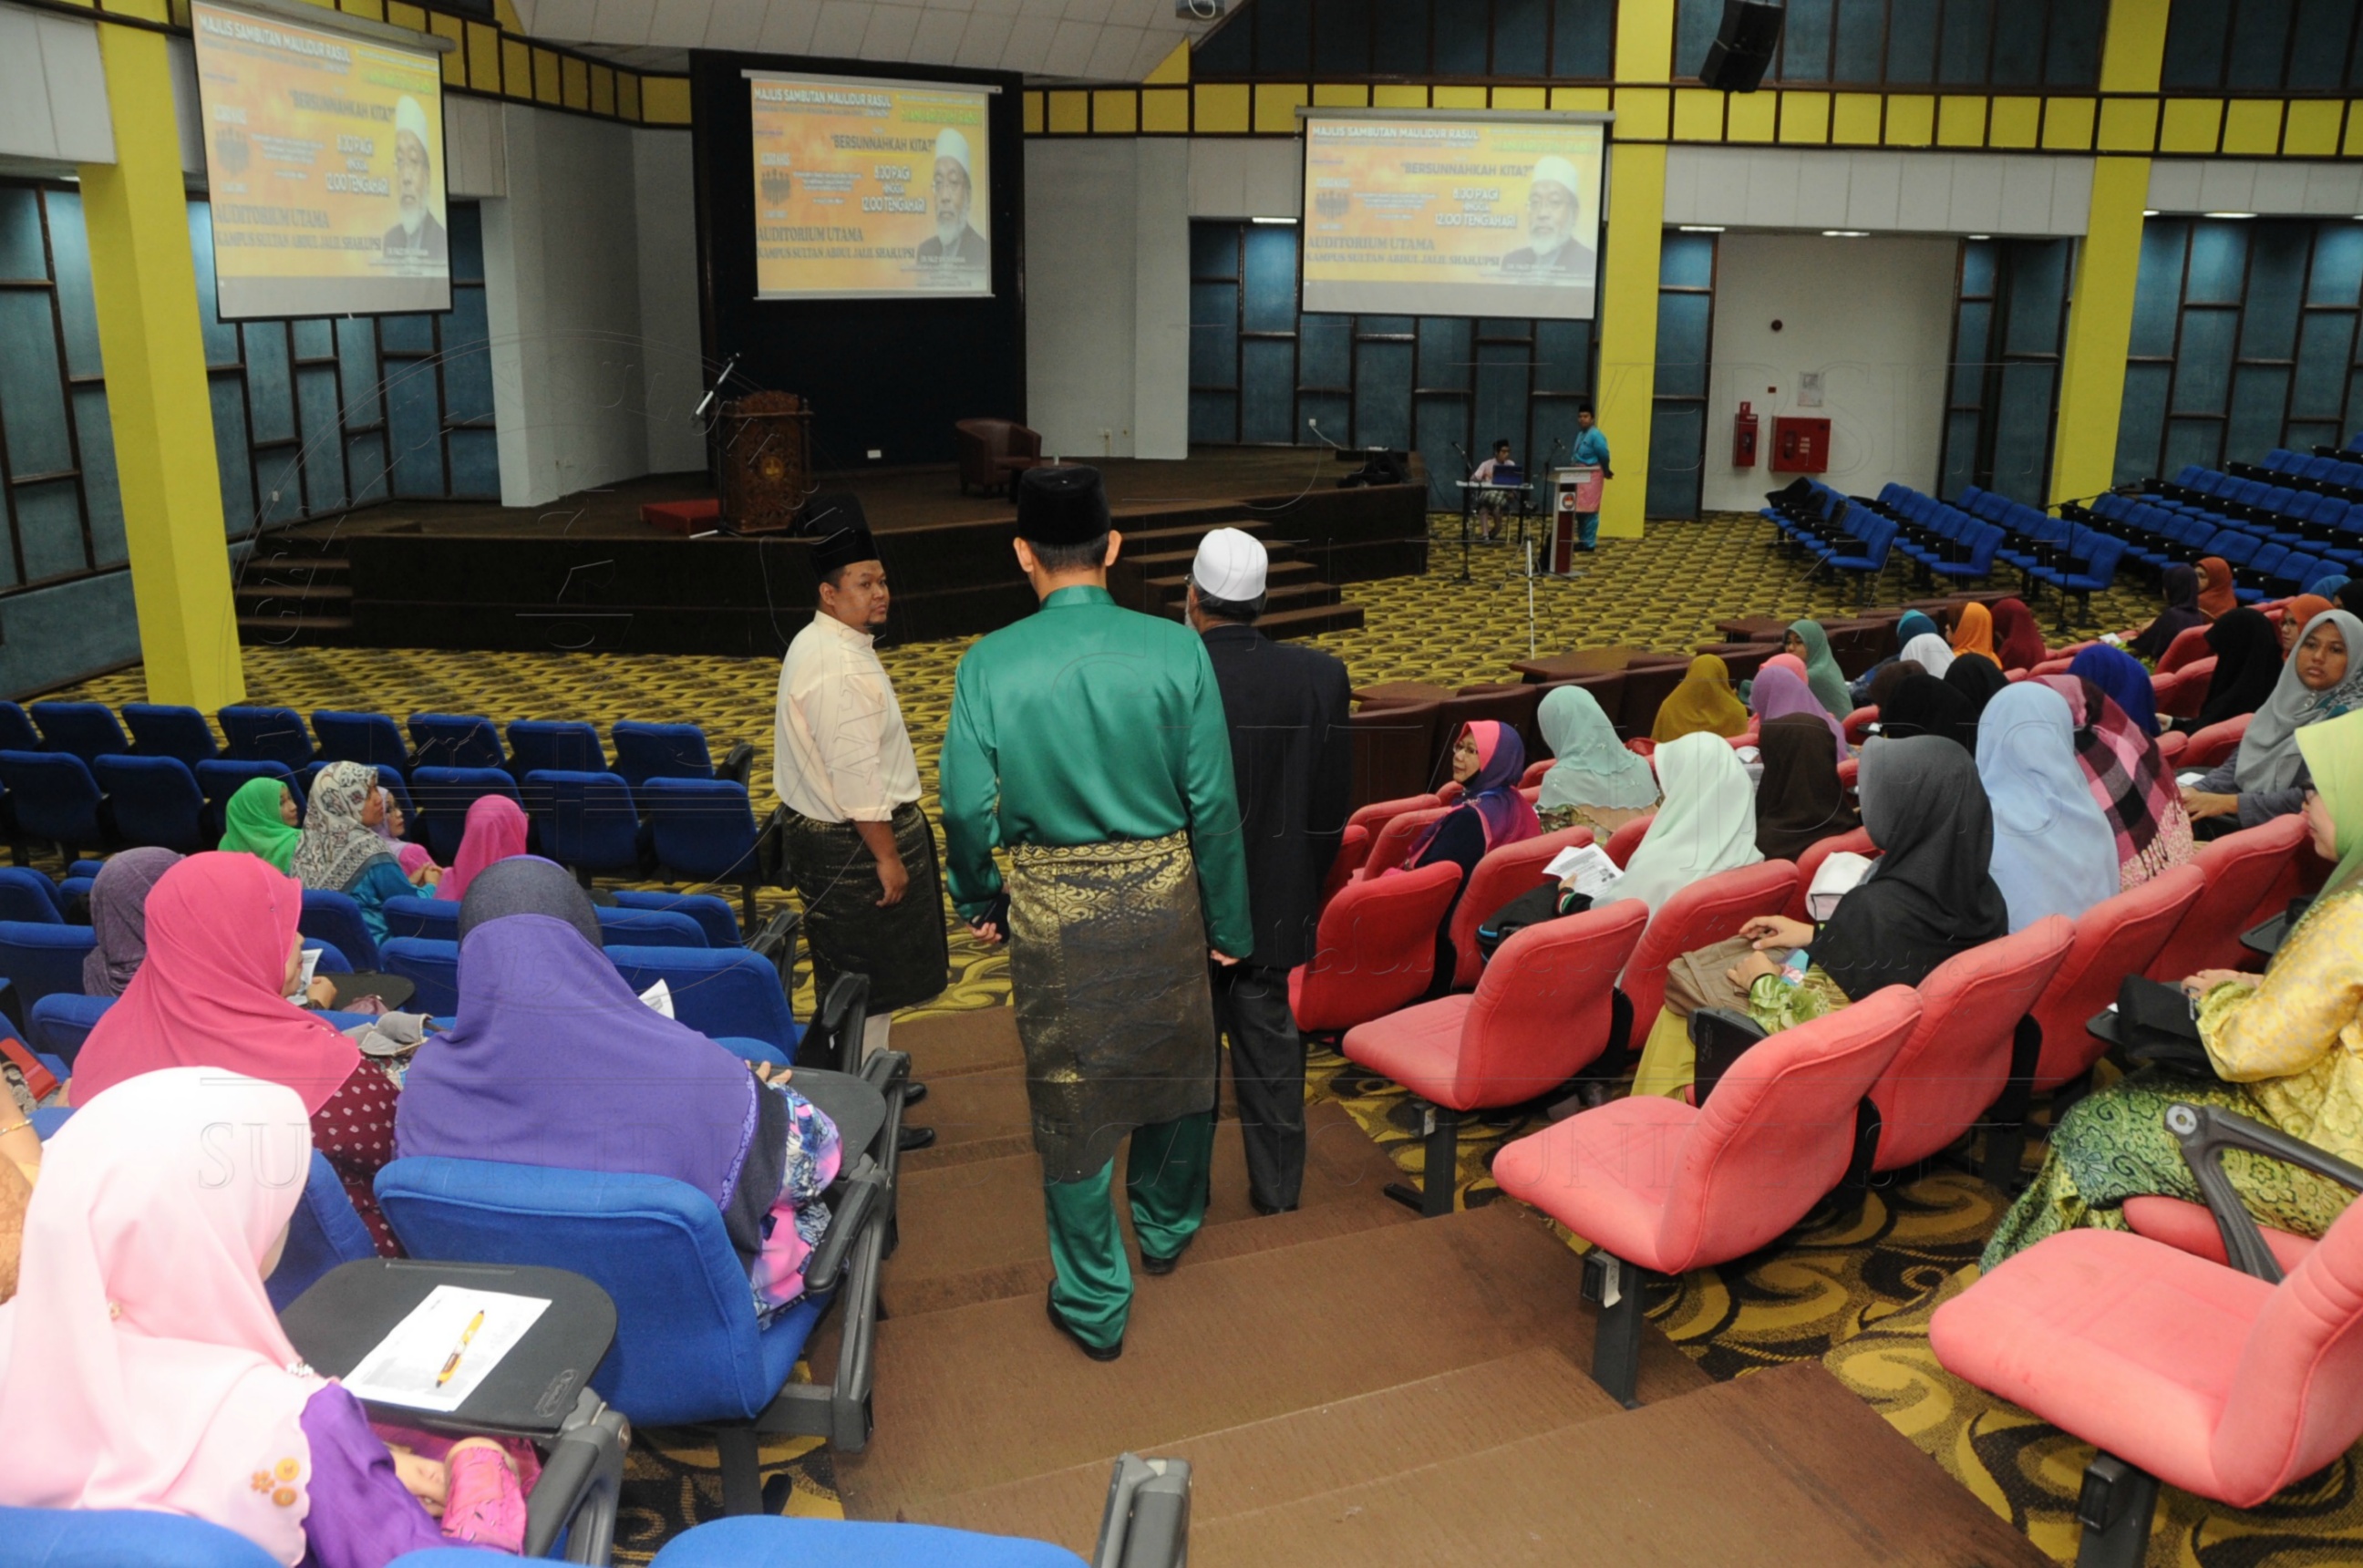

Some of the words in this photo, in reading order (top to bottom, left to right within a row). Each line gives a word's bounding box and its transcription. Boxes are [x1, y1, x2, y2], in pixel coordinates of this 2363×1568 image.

[199, 15, 234, 37] MAJLIS
[234, 22, 282, 46] SAMBUTAN
[754, 87, 783, 101] MAJLIS
[784, 89, 825, 103] SAMBUTAN
[867, 94, 892, 108] RASUL
[1312, 126, 1345, 137] MAJLIS
[1347, 127, 1398, 138] SAMBUTAN
[1399, 128, 1447, 139] MAULIDUR
[1449, 129, 1479, 139] RASUL
[892, 166, 911, 181] PAGI
[1475, 189, 1499, 201] PAGI
[884, 197, 925, 213] TENGAHARI
[215, 203, 289, 225] AUDITORIUM
[291, 209, 330, 229] UTAMA
[1463, 215, 1517, 228] TENGAHARI
[758, 225, 824, 242] AUDITORIUM
[827, 226, 863, 242] UTAMA
[1306, 236, 1388, 250] AUDITORIUM
[1389, 237, 1435, 251] UTAMA
[758, 246, 791, 259] KAMPUS
[792, 247, 823, 259] SULTAN
[1305, 253, 1346, 263] KAMPUS
[1347, 253, 1385, 263] SULTAN
[1388, 254, 1419, 264] ABDUL
